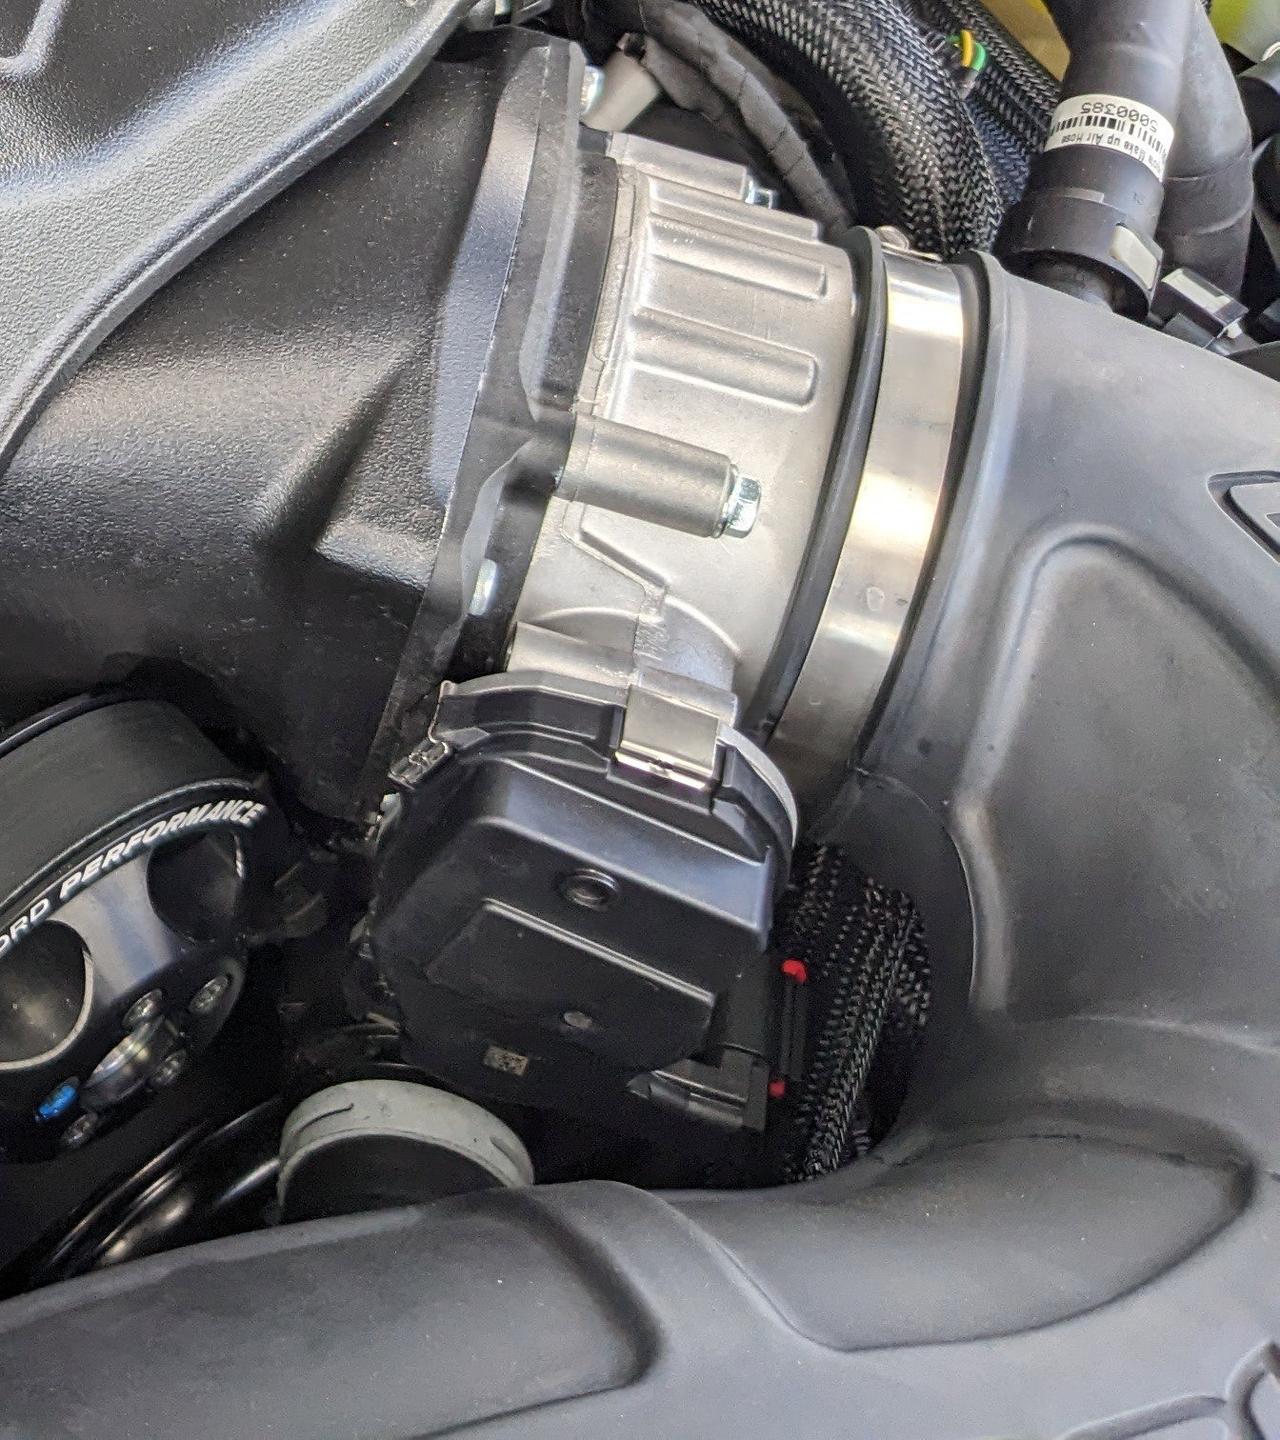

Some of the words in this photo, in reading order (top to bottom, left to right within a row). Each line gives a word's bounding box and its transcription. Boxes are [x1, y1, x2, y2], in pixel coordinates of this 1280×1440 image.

[1080, 102, 1158, 133] 5000385
[1107, 134, 1120, 146] up
[60, 799, 267, 899] PERFORMANCE
